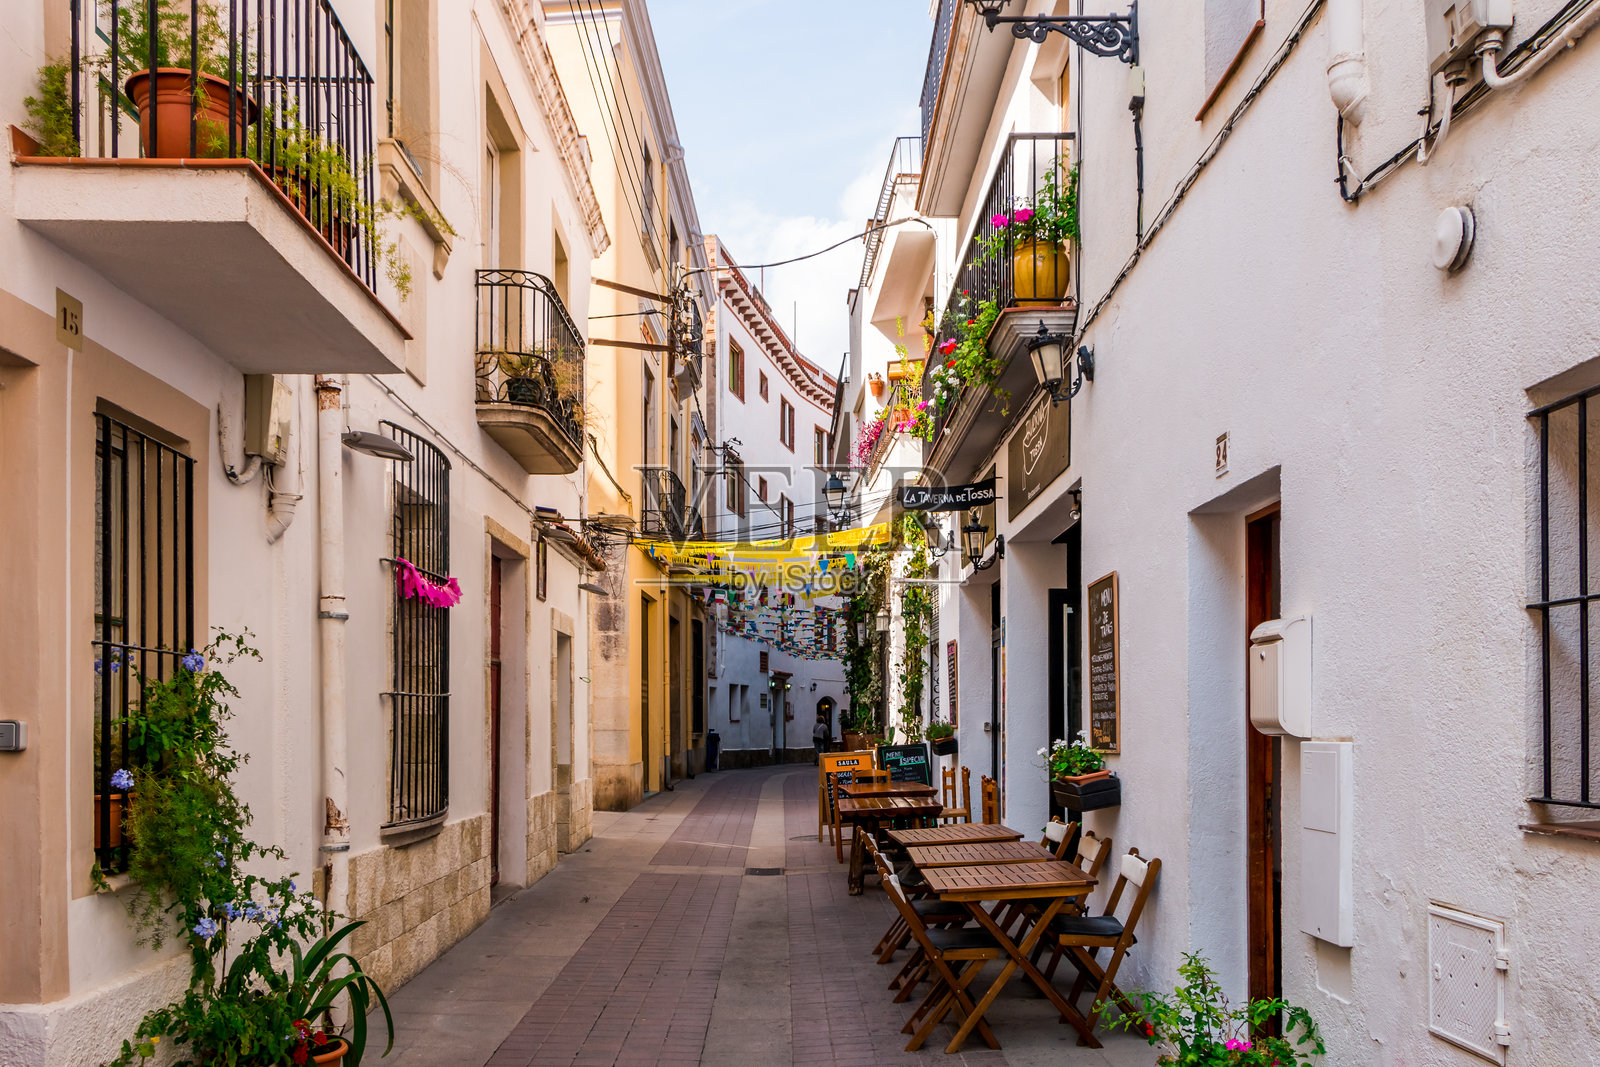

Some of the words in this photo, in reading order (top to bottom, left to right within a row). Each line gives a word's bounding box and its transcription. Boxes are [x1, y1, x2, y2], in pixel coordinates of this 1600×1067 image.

[61, 306, 79, 336] 15
[1216, 440, 1227, 467] 24
[963, 487, 994, 502] TOSSA
